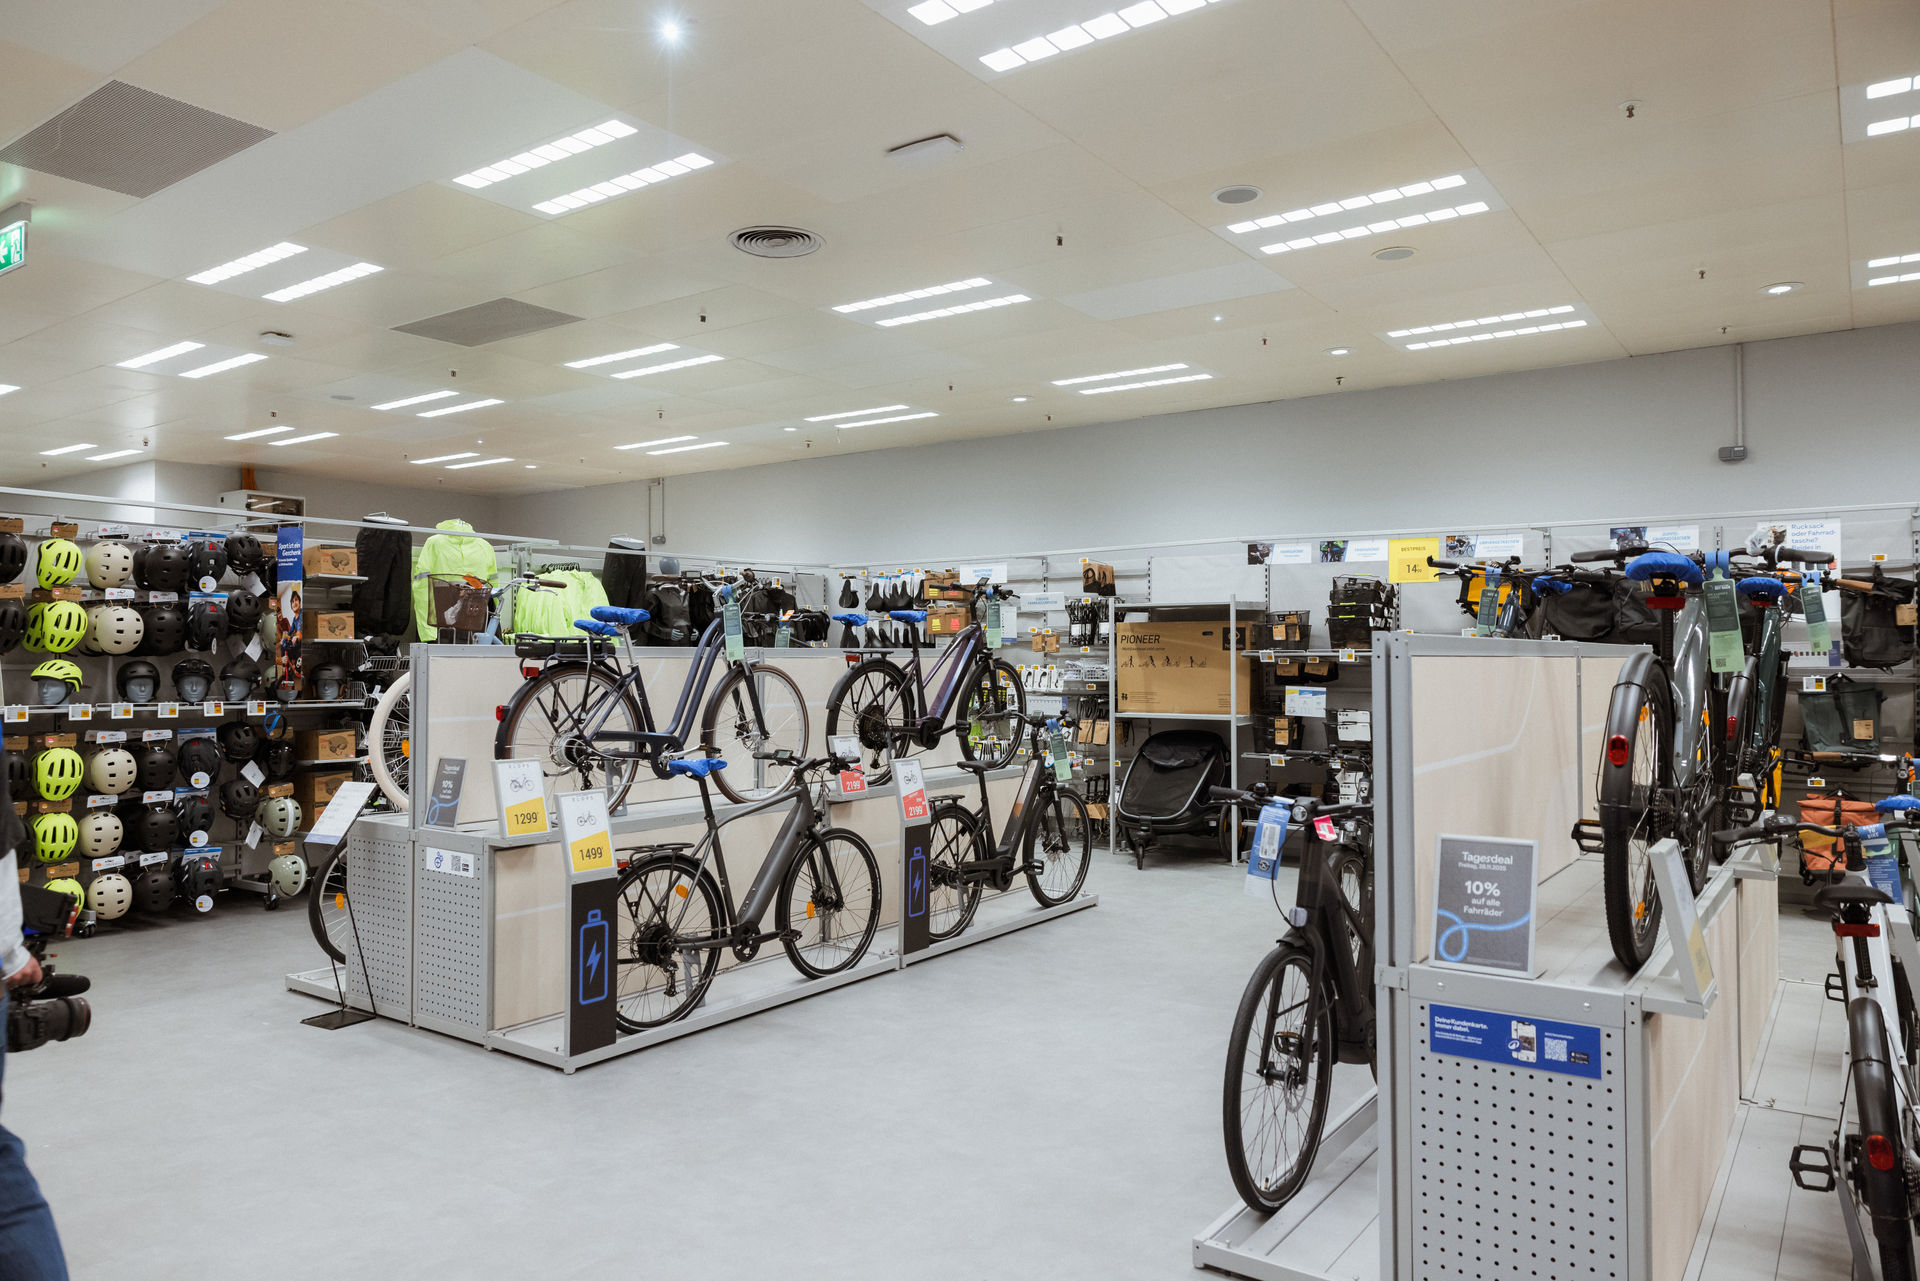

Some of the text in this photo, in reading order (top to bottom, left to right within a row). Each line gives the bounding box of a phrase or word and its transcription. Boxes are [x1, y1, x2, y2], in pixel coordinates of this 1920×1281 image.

[1120, 634, 1161, 644] PIONEER
[514, 811, 538, 825] 1299
[579, 847, 603, 861] 1499
[1462, 851, 1513, 865] Tagesdeal
[1465, 880, 1501, 897] 10%
[1486, 898, 1501, 907] alle
[1434, 1015, 1451, 1024] Deine
